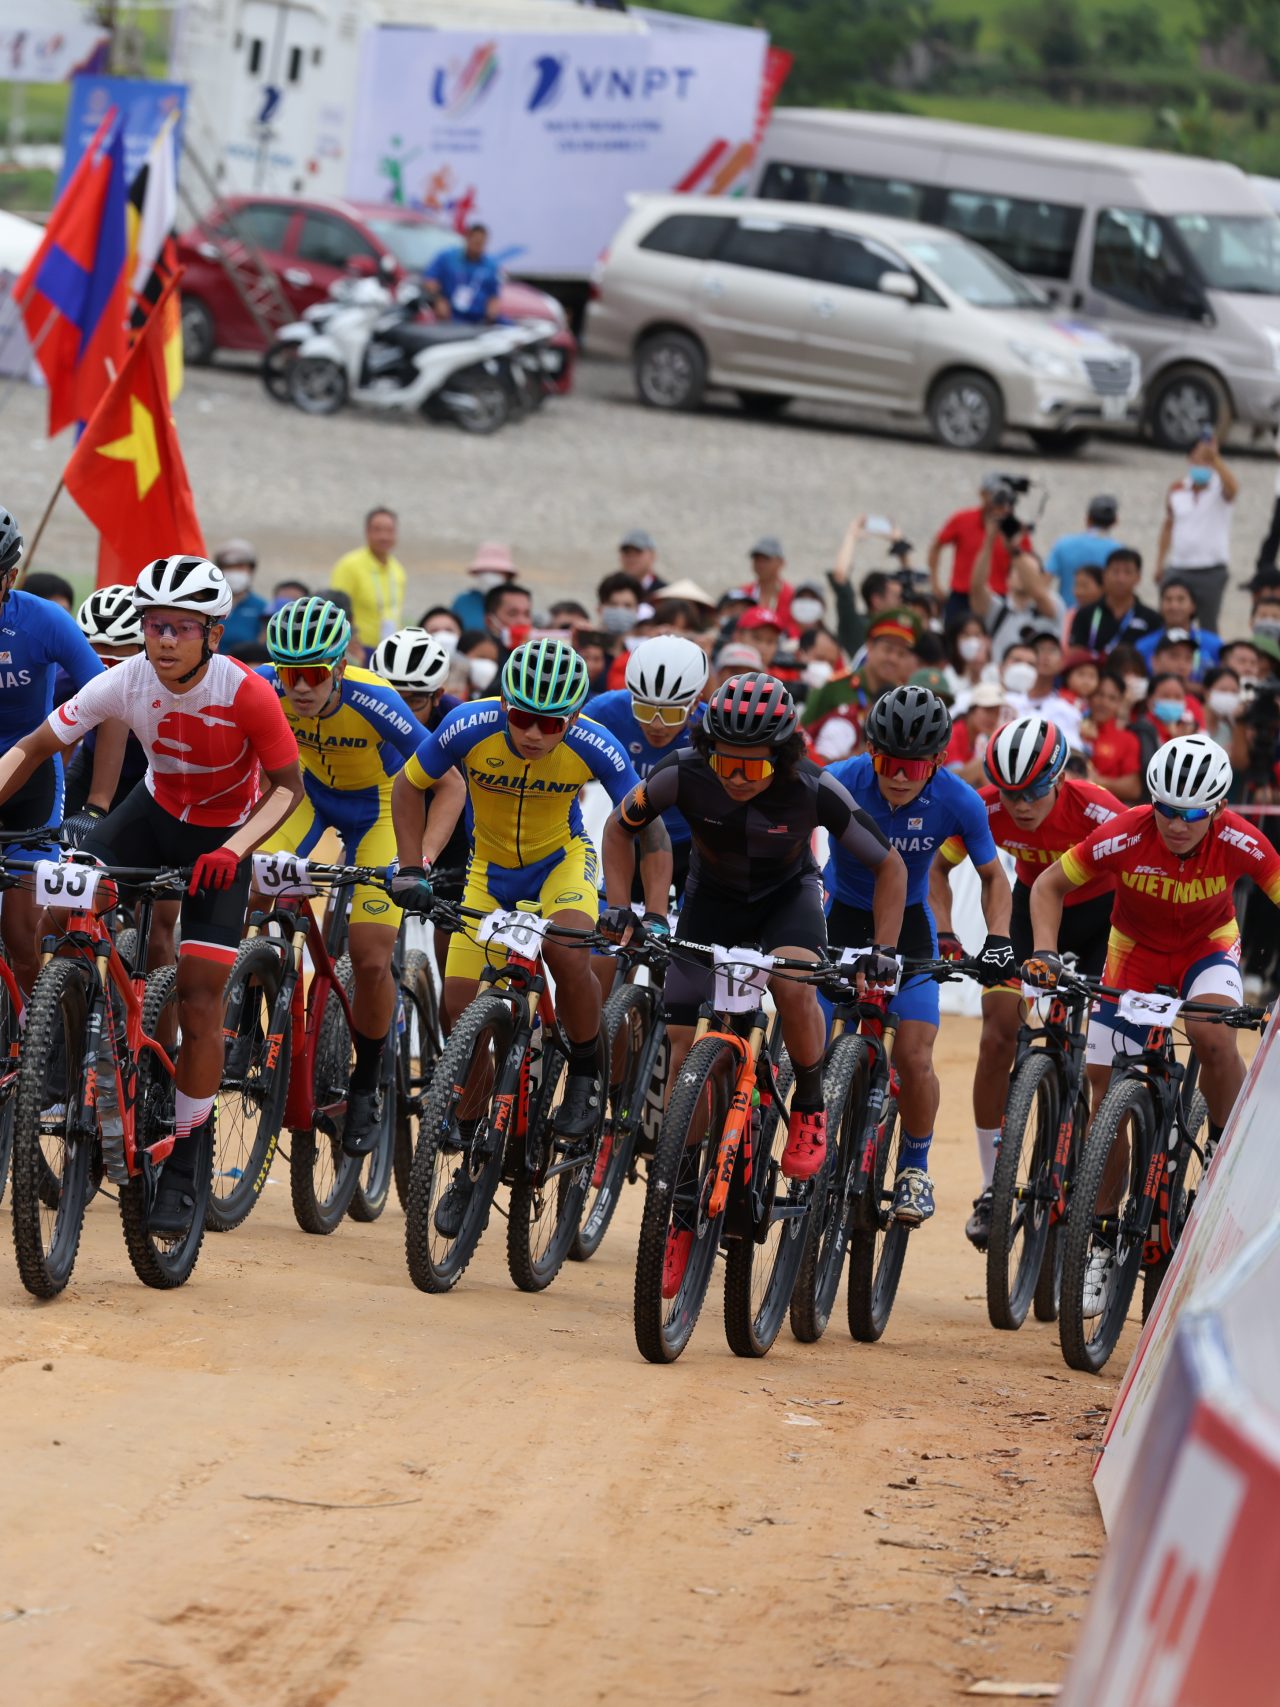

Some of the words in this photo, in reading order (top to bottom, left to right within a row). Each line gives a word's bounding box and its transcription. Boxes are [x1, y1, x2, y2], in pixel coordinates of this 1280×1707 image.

[576, 67, 695, 98] VNPT
[351, 690, 413, 735] THAILAND
[438, 710, 499, 749] THAILAND
[291, 726, 368, 749] AILAND
[569, 725, 626, 773] THAILAND
[470, 767, 580, 793] THAILAND
[261, 856, 301, 887] 34
[1121, 871, 1227, 904] VIETNAM
[723, 962, 760, 997] 12
[252, 1134, 277, 1193] MAXXIS
